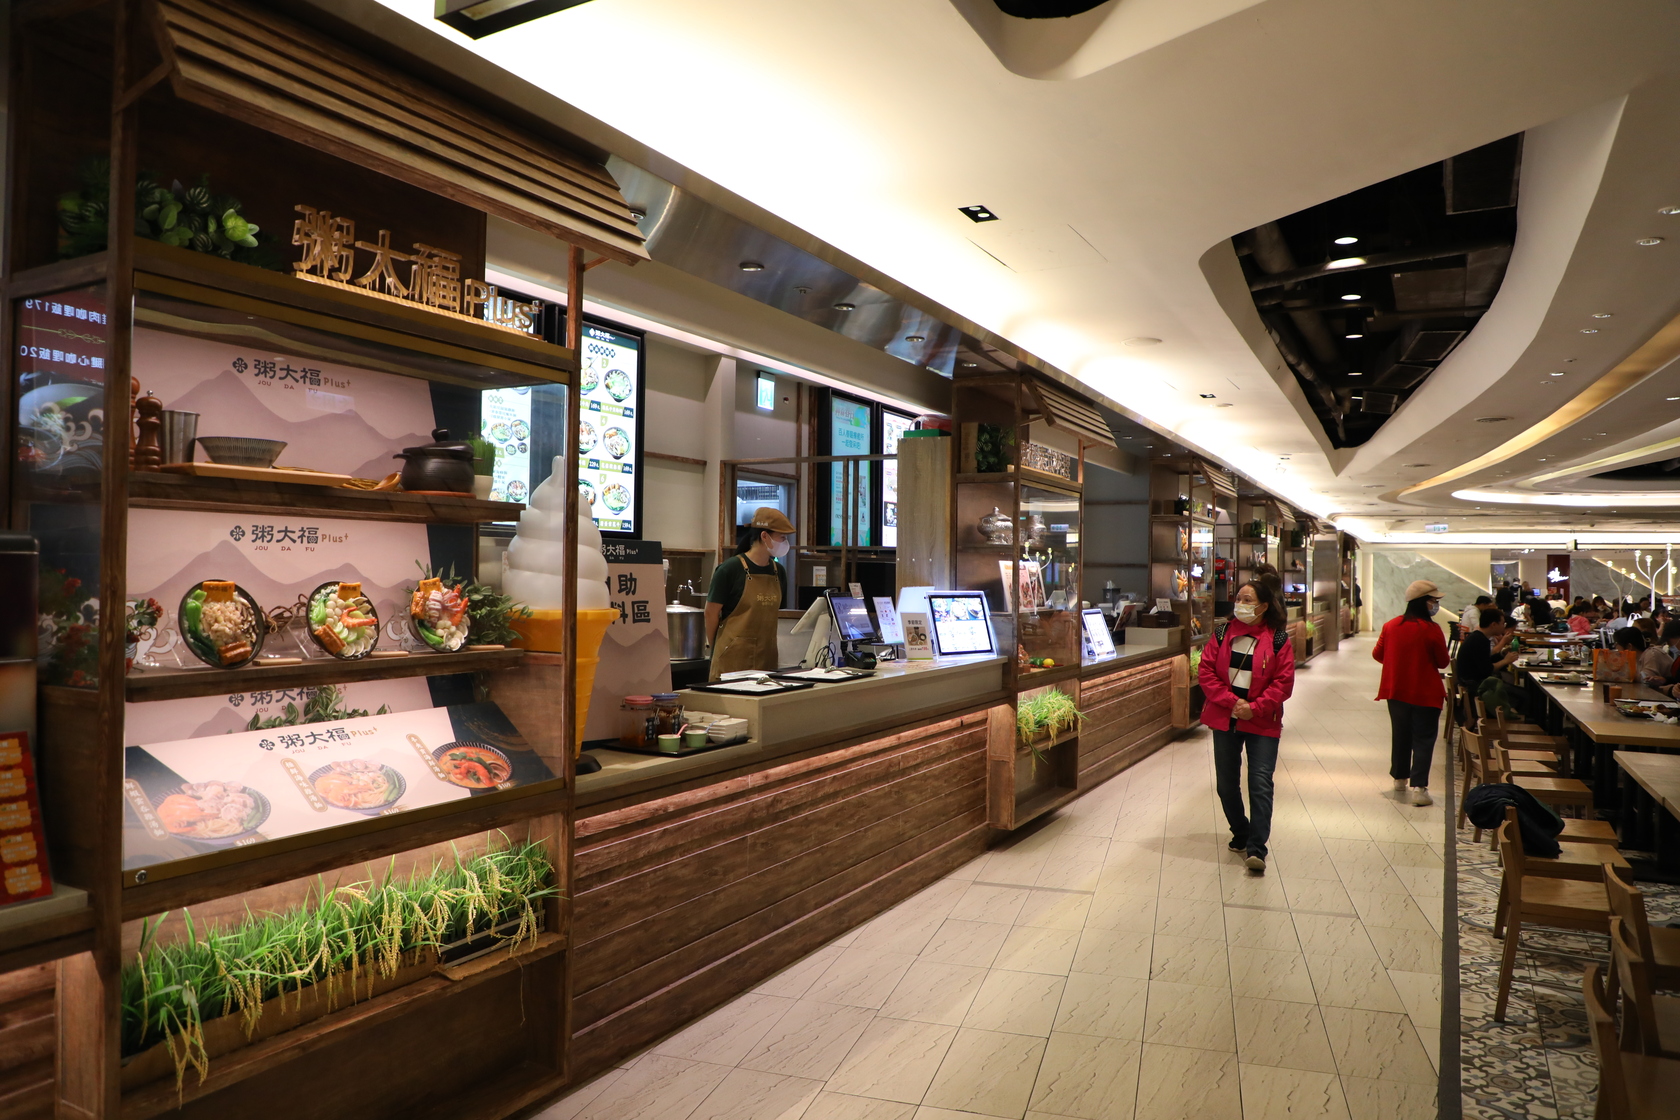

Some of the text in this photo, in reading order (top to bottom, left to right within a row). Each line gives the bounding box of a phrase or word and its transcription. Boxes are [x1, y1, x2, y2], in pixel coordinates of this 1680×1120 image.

[292, 204, 462, 312] 粥大福
[254, 359, 321, 386] 粥大福
[284, 383, 295, 391] DA
[251, 525, 319, 544] 粥大福
[605, 572, 638, 596] 助
[278, 727, 351, 749] 粥大福
